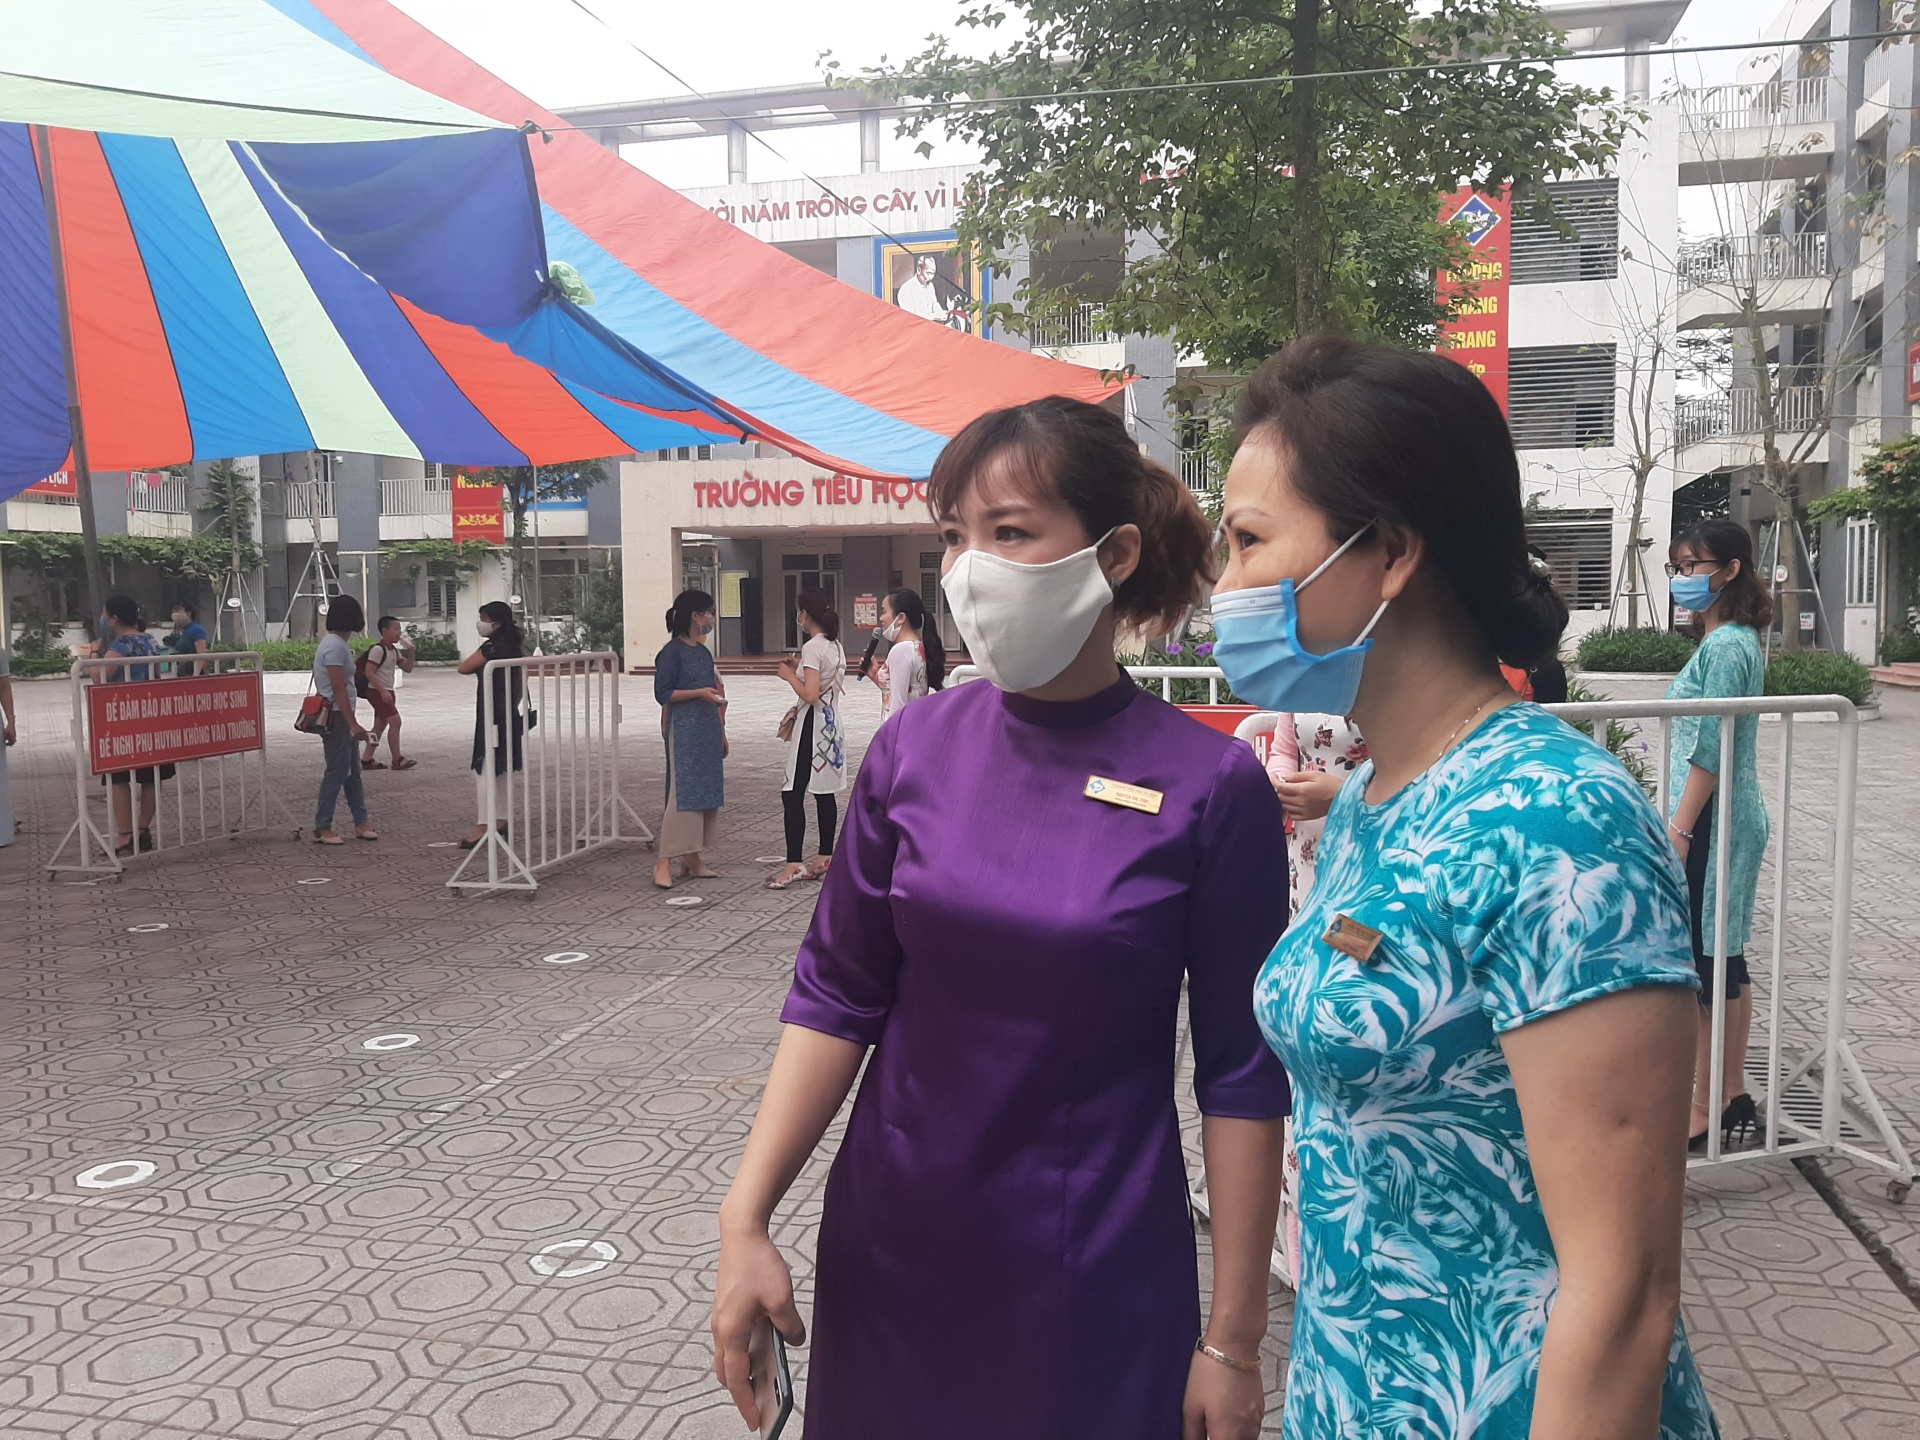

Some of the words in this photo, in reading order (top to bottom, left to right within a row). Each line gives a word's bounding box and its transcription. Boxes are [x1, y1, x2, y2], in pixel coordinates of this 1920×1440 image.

[742, 198, 790, 224] NĂM
[872, 187, 919, 213] CÂY,
[924, 181, 946, 209] VÌ
[693, 471, 805, 507] TRƯỜNG
[141, 692, 159, 718] BẢO
[160, 697, 173, 716] AN
[173, 691, 195, 715] TOÀN
[195, 693, 212, 713] CHO
[213, 691, 229, 714] HỌC
[229, 690, 248, 709] SINH
[113, 734, 135, 759] NGHỊ
[135, 732, 153, 756] PHỤ
[154, 728, 182, 750] HUYNH
[210, 719, 227, 743] VÀO
